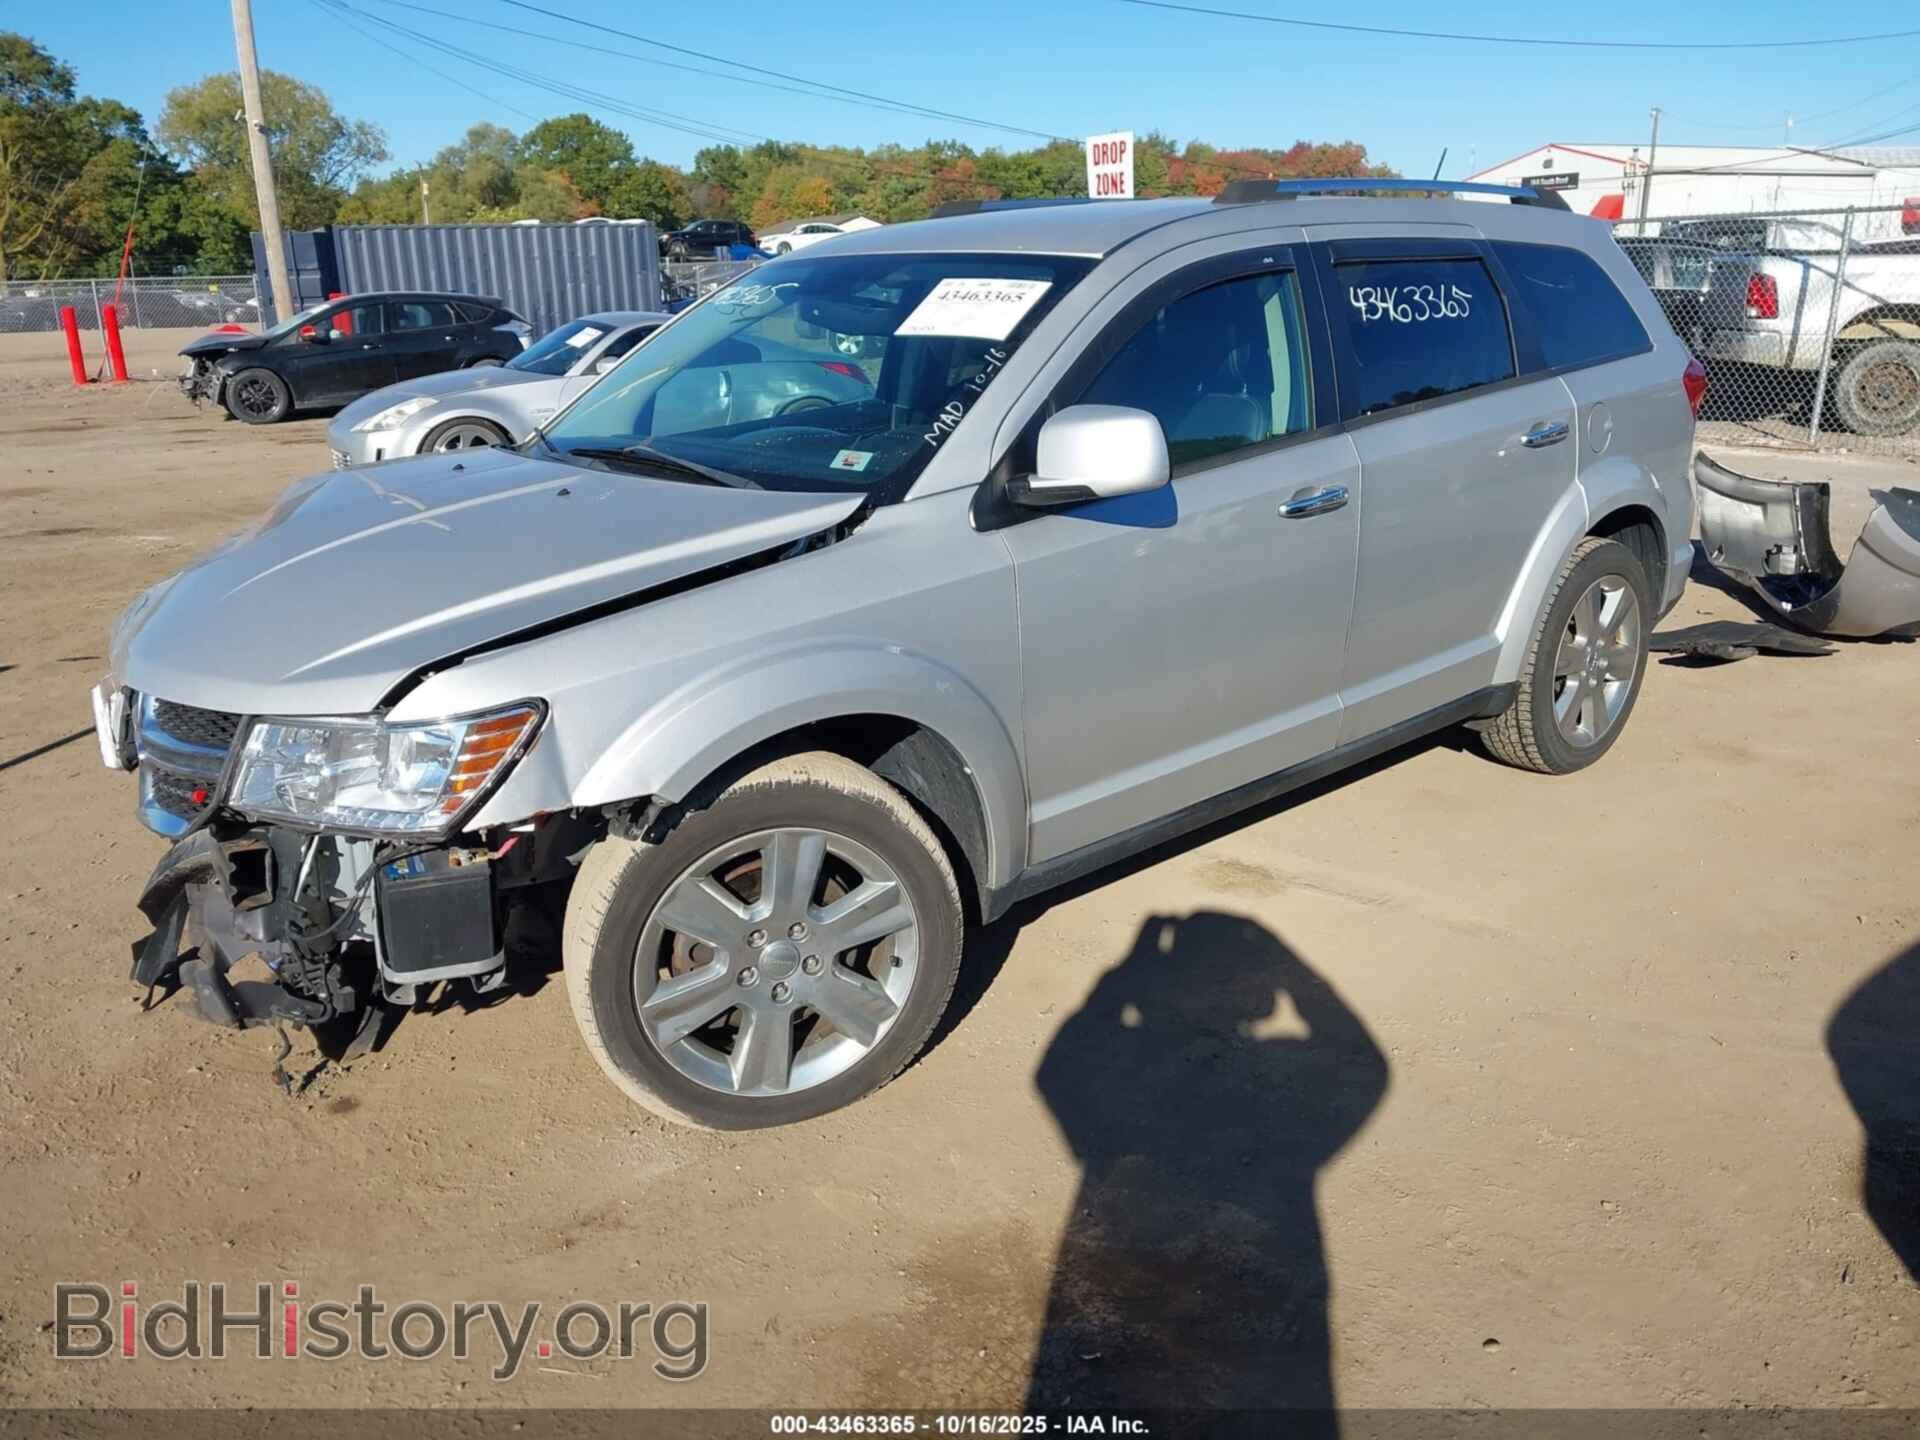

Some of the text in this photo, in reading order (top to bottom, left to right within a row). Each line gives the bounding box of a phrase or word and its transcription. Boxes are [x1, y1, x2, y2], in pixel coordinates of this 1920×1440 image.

[1093, 140, 1127, 166] DROP
[1096, 171, 1126, 196] ZONE
[937, 289, 1027, 303] 43463365
[1349, 284, 1473, 323] 43463365
[923, 347, 1007, 447] MAD 10-16
